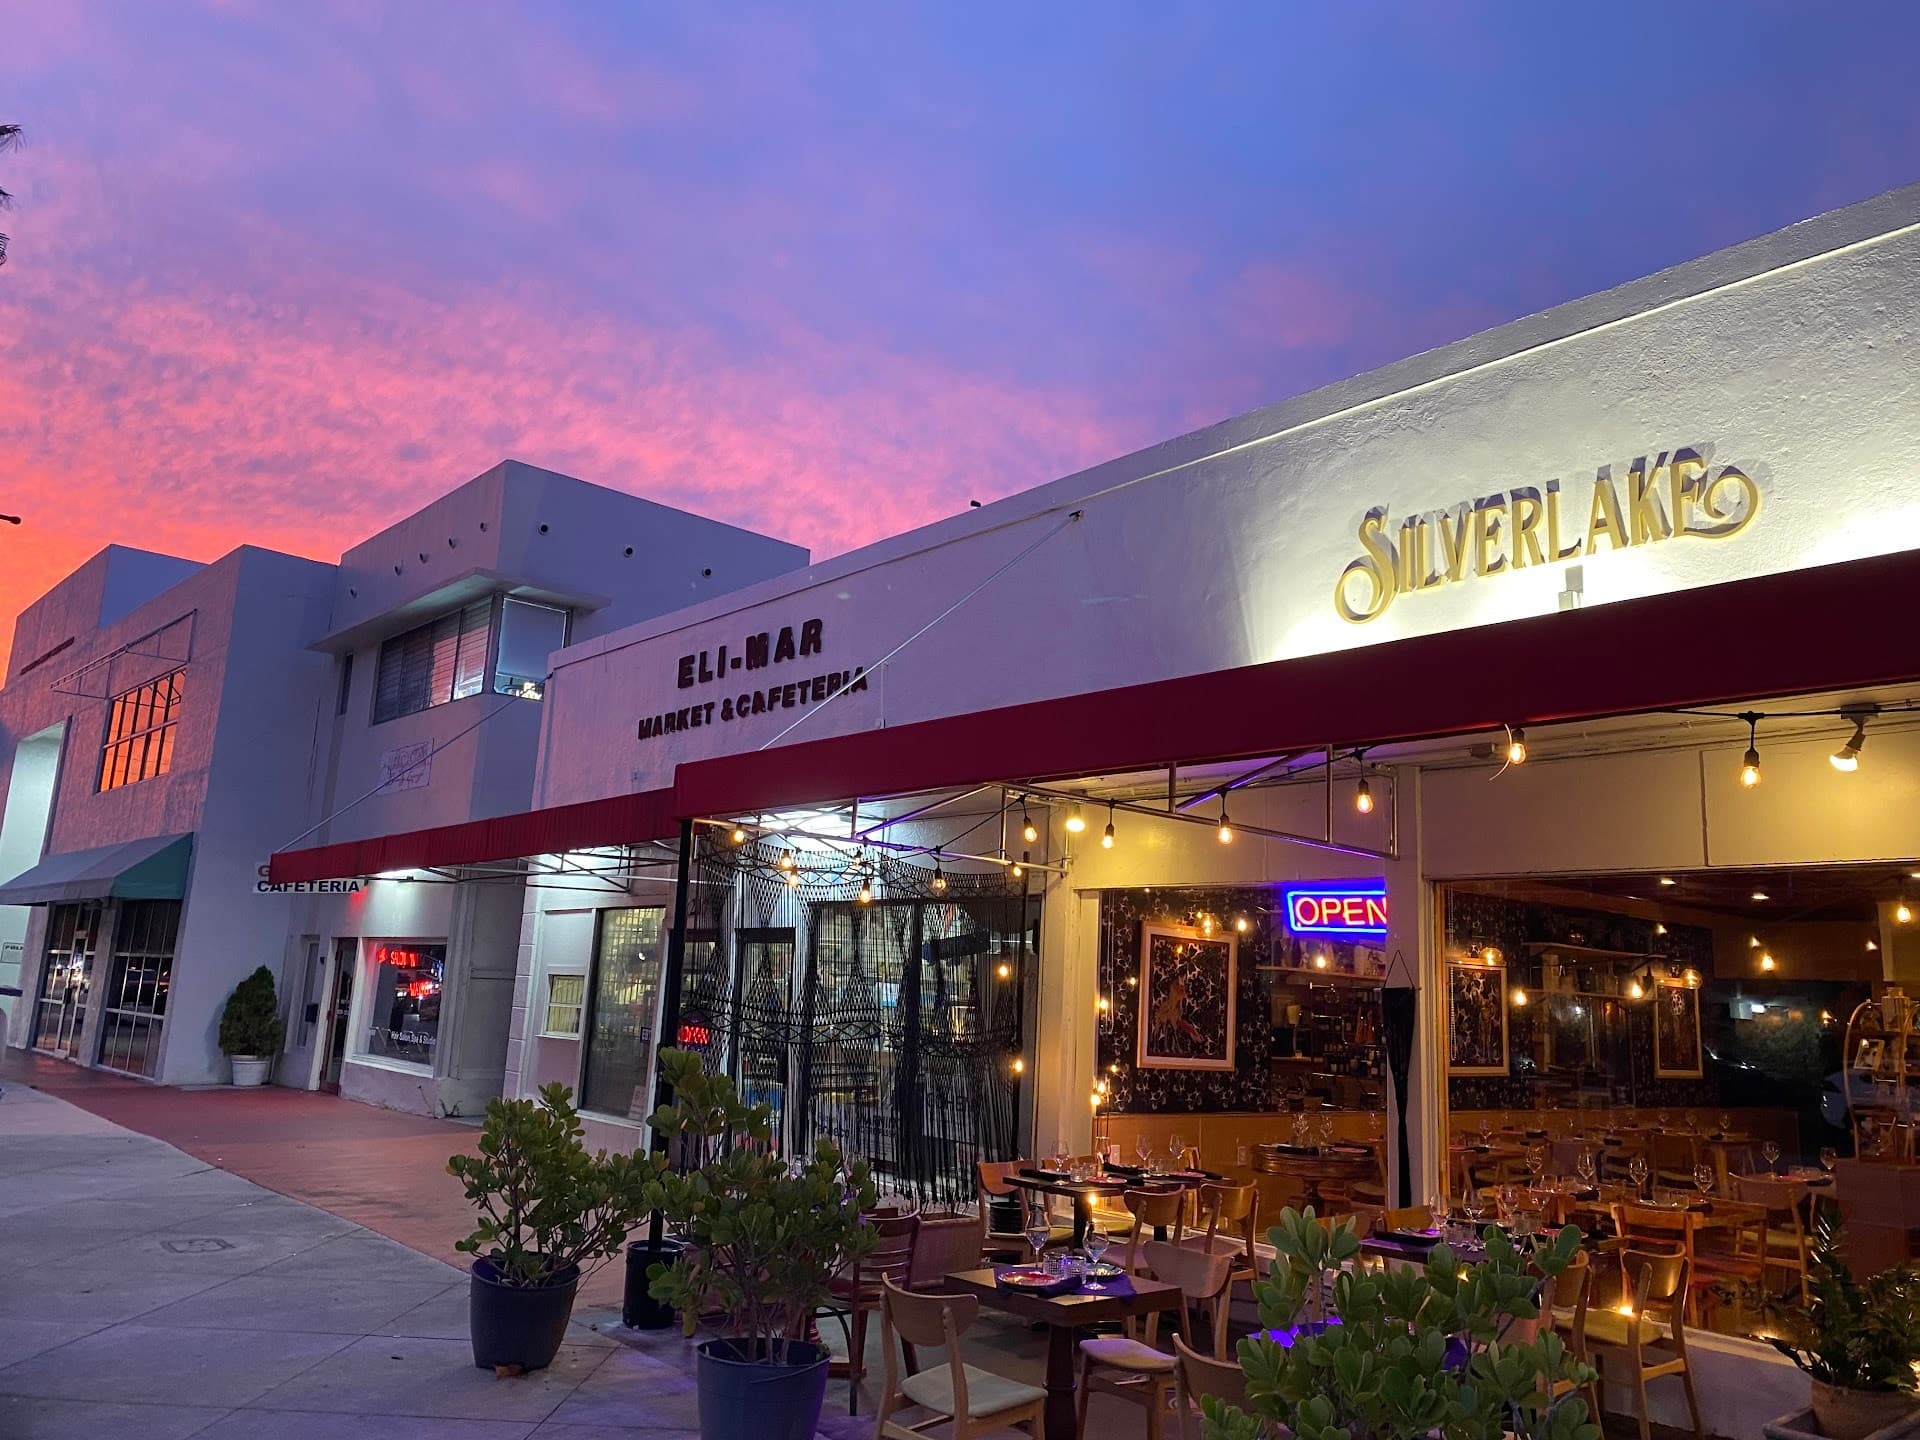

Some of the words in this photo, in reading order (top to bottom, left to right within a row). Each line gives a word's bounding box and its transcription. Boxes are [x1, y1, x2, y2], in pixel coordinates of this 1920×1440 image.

[1334, 450, 1761, 624] SILVERLAKE
[677, 618, 823, 689] ELI-MAR
[638, 701, 715, 740] MARKET
[257, 881, 360, 893] CAFETERIA
[1295, 897, 1387, 926] OPEN
